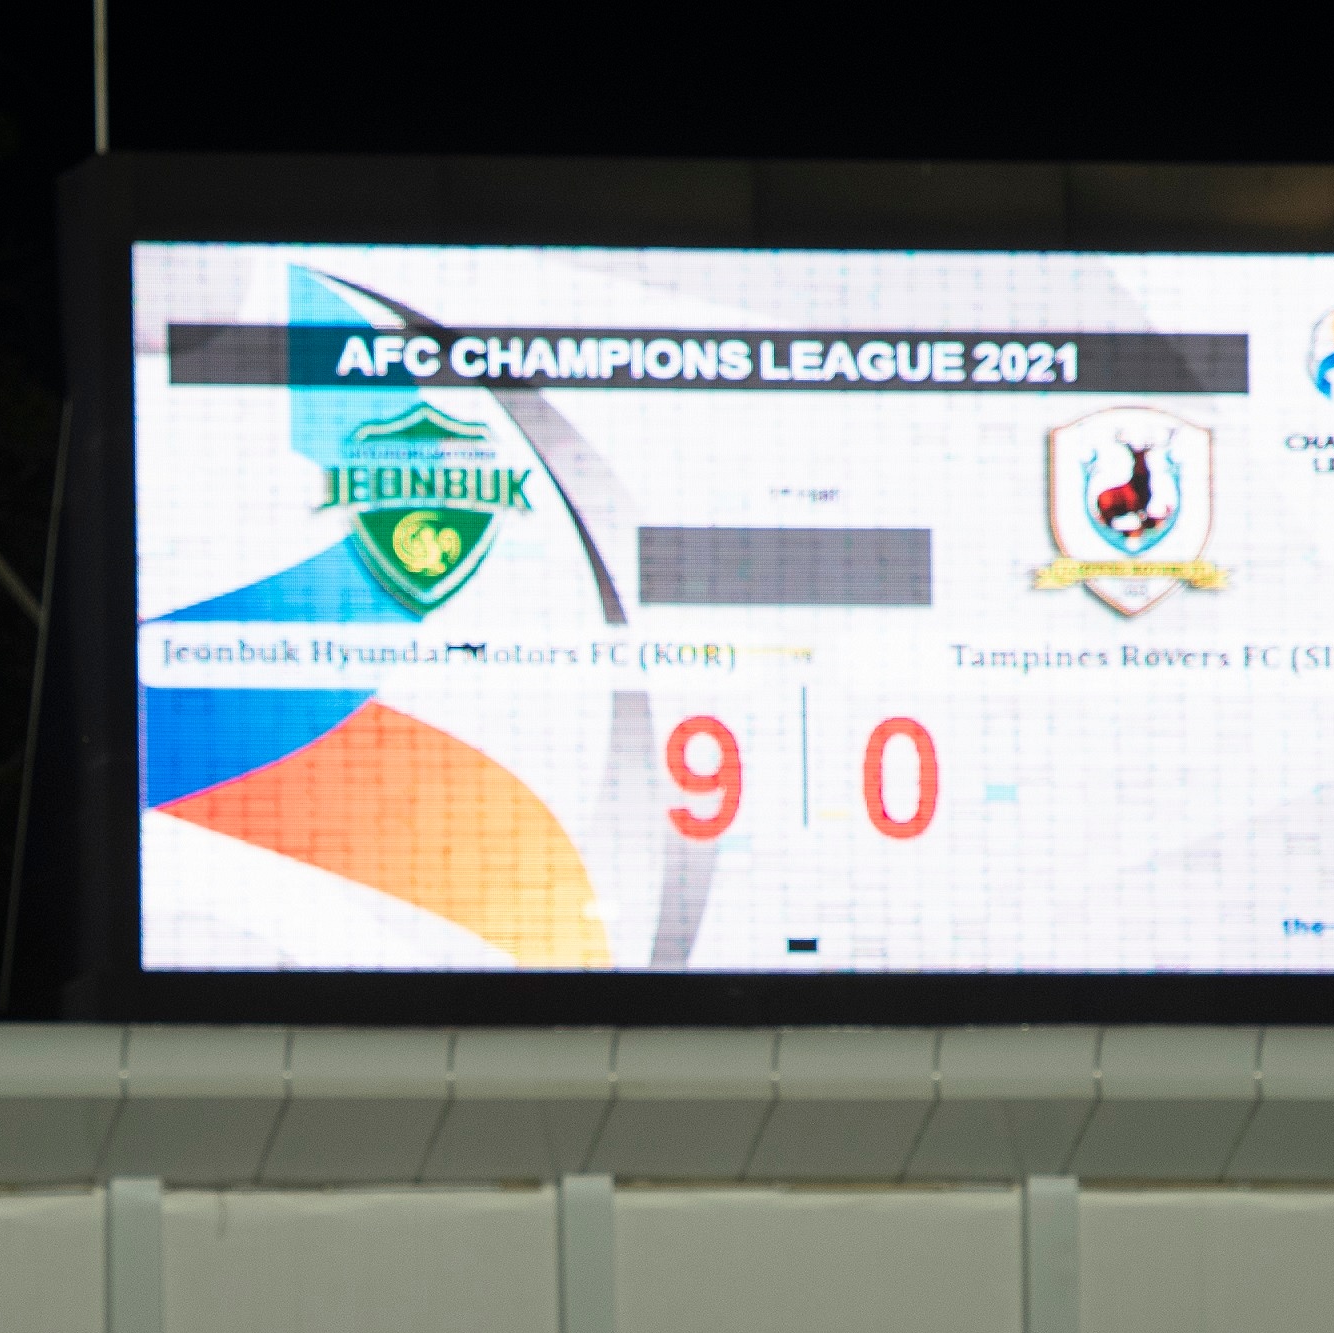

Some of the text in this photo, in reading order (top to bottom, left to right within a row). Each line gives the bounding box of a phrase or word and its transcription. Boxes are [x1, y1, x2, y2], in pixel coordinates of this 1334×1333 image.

[336, 336, 1079, 383] AFC CHAMPIONS LEAGUE 2021
[311, 466, 534, 513] JEONBUK
[163, 639, 300, 667] Jeonbuk
[592, 642, 628, 665] FC
[639, 641, 737, 672] (KOR)
[950, 643, 1109, 674] Tampines
[1121, 643, 1230, 668] Rovers
[1243, 644, 1281, 668] FC
[664, 714, 939, 842] 9 0
